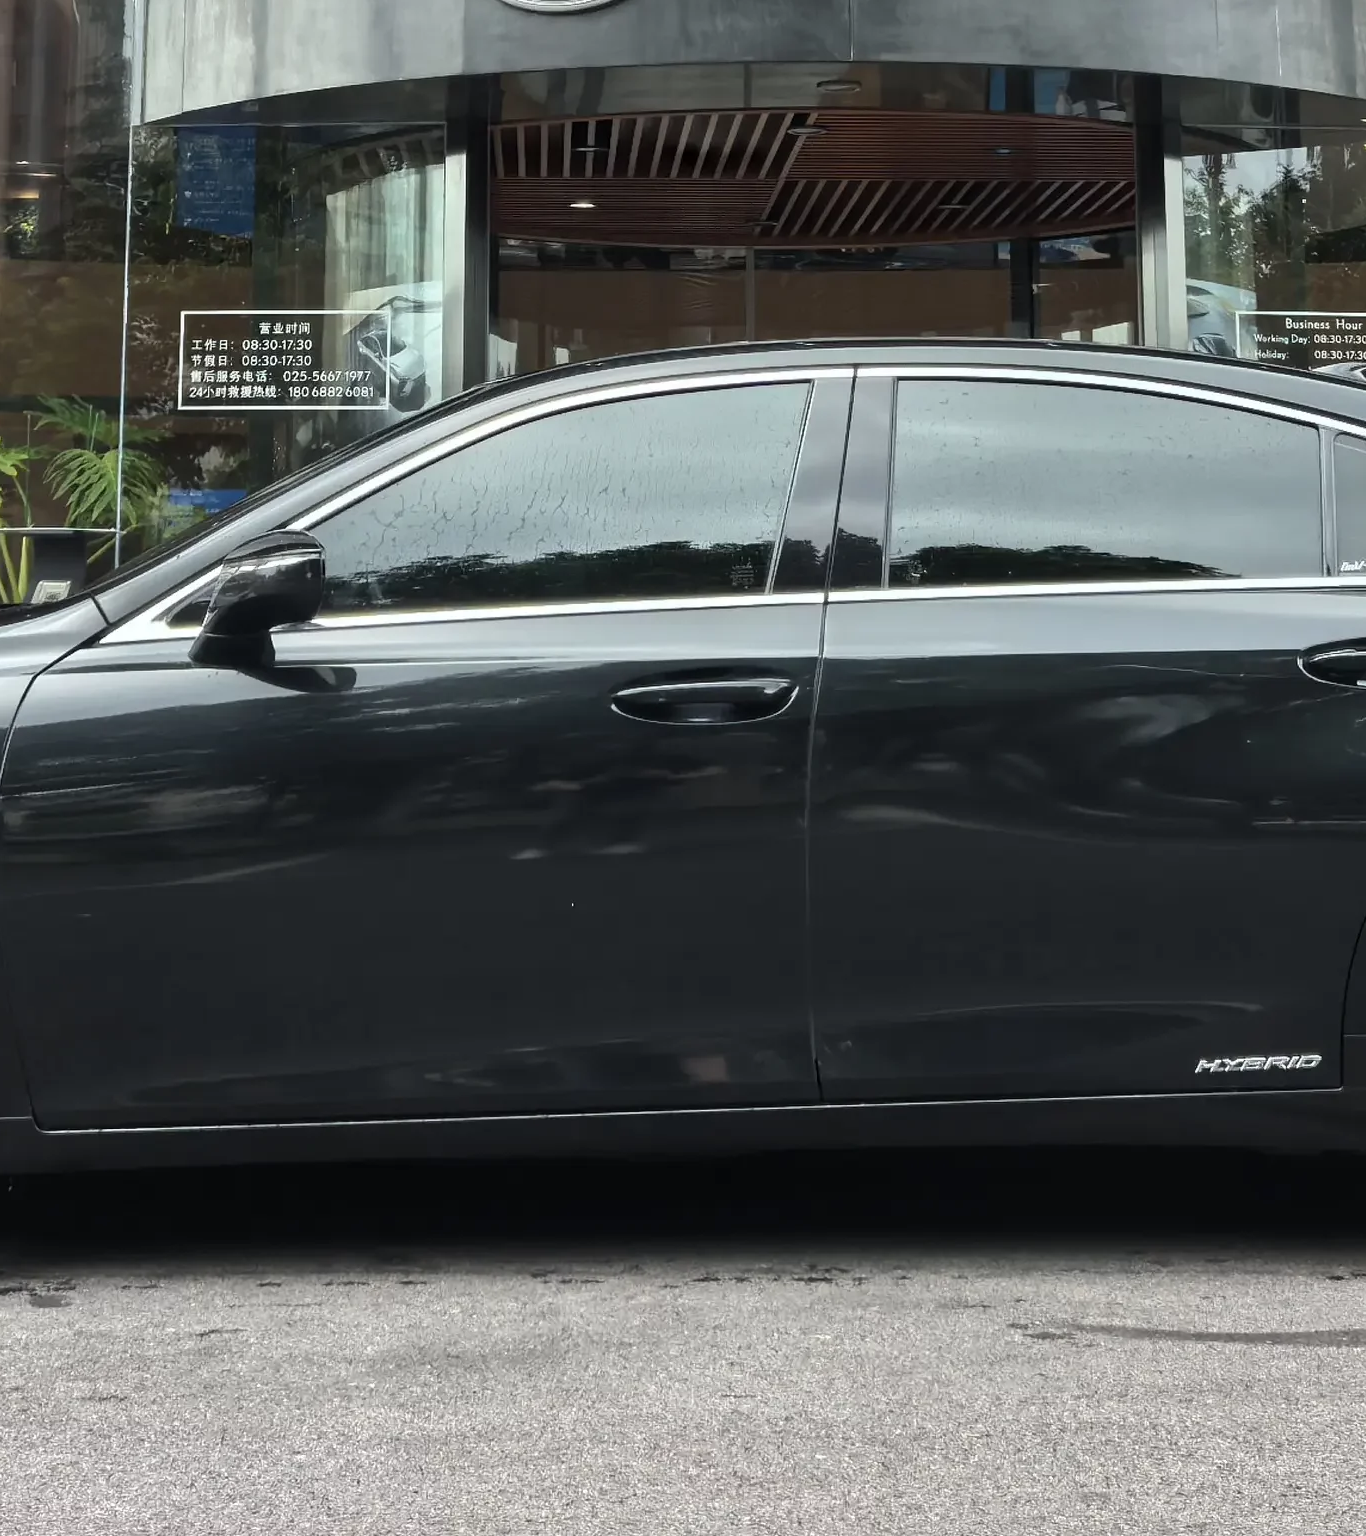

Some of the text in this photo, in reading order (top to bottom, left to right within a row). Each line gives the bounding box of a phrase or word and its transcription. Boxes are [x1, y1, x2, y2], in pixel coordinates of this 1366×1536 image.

[259, 321, 311, 335] 营业时间
[1285, 317, 1364, 330] Business Hour
[242, 339, 313, 351] 08:30-17:30
[1254, 333, 1289, 345] Working
[1291, 334, 1311, 345] Day:
[241, 355, 312, 366] 08:30-17:30
[1254, 350, 1290, 360] Holiday:
[282, 371, 341, 382] 025-5667
[344, 370, 371, 381] 1977
[288, 386, 309, 398] 180
[311, 386, 343, 398] 6882
[344, 386, 374, 397] 6081
[1194, 1054, 1323, 1074] HYBRID
